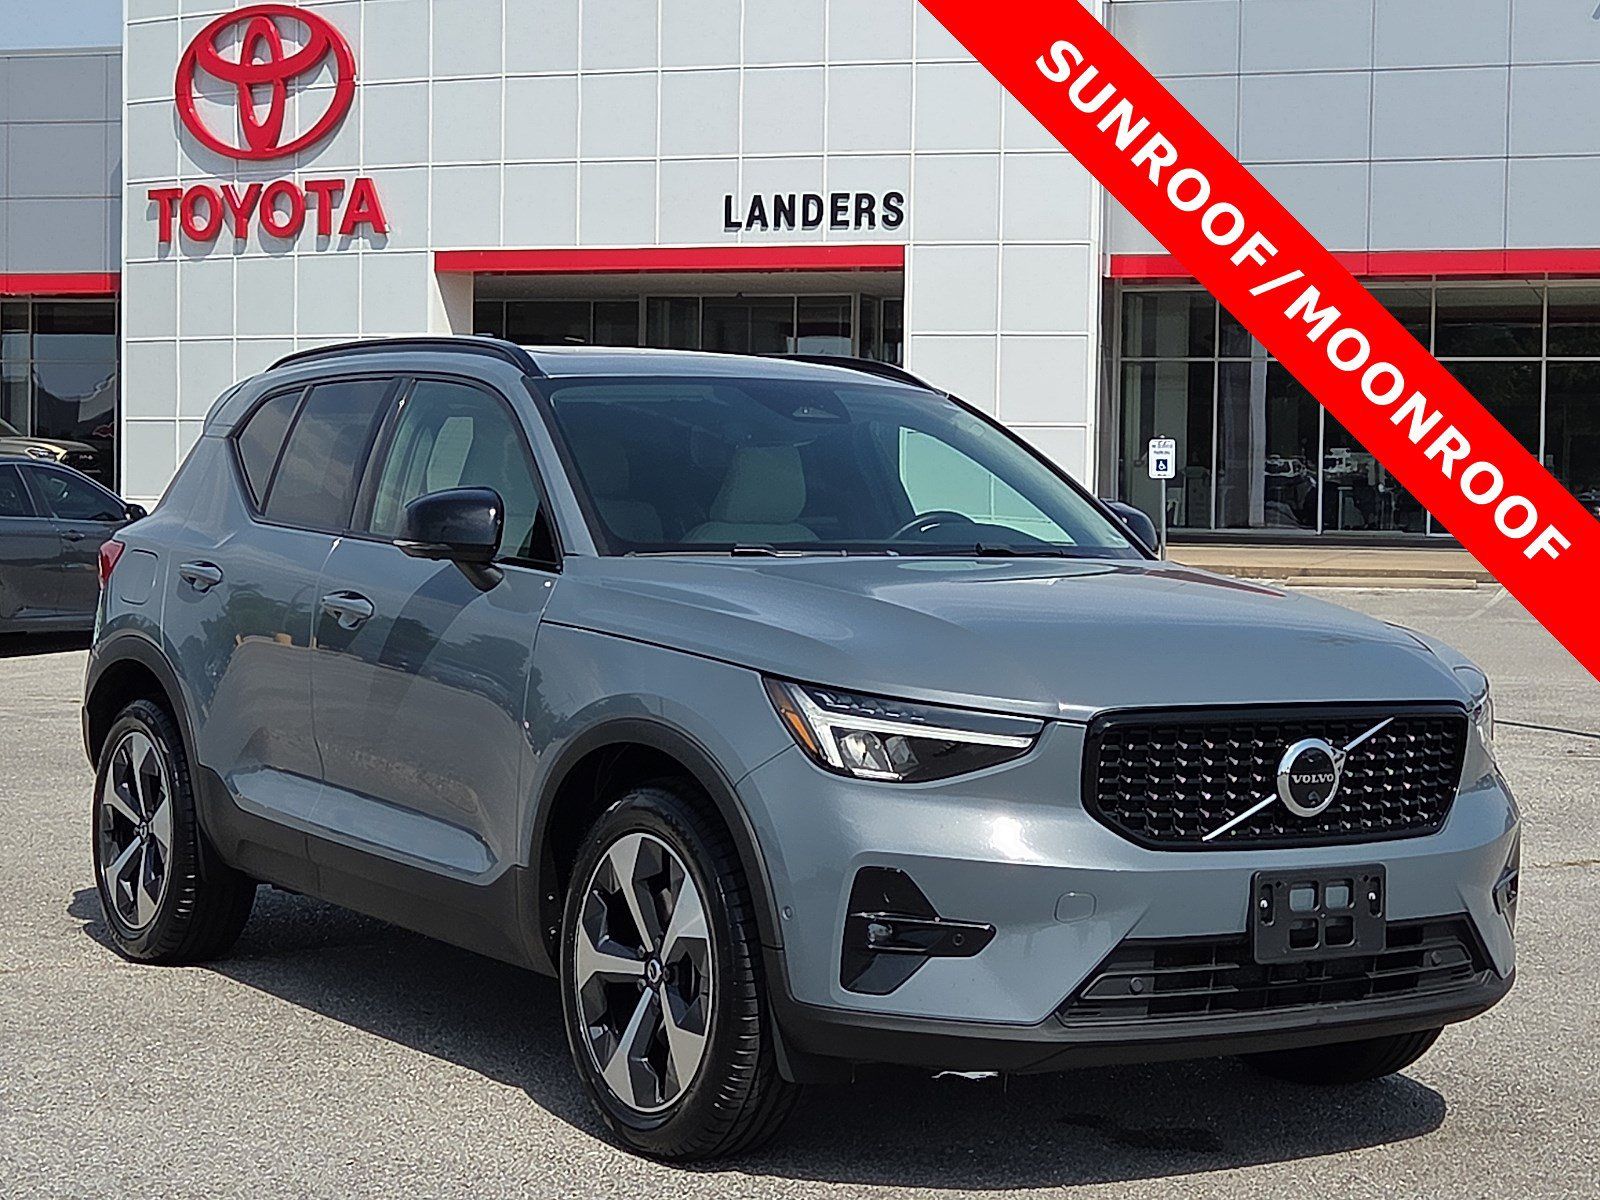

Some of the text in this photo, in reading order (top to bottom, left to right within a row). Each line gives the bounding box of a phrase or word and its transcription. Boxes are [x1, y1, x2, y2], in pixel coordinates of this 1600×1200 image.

[148, 178, 390, 243] TOYOTA
[724, 191, 904, 232] LANDERS
[1291, 773, 1334, 784] VOLVO
